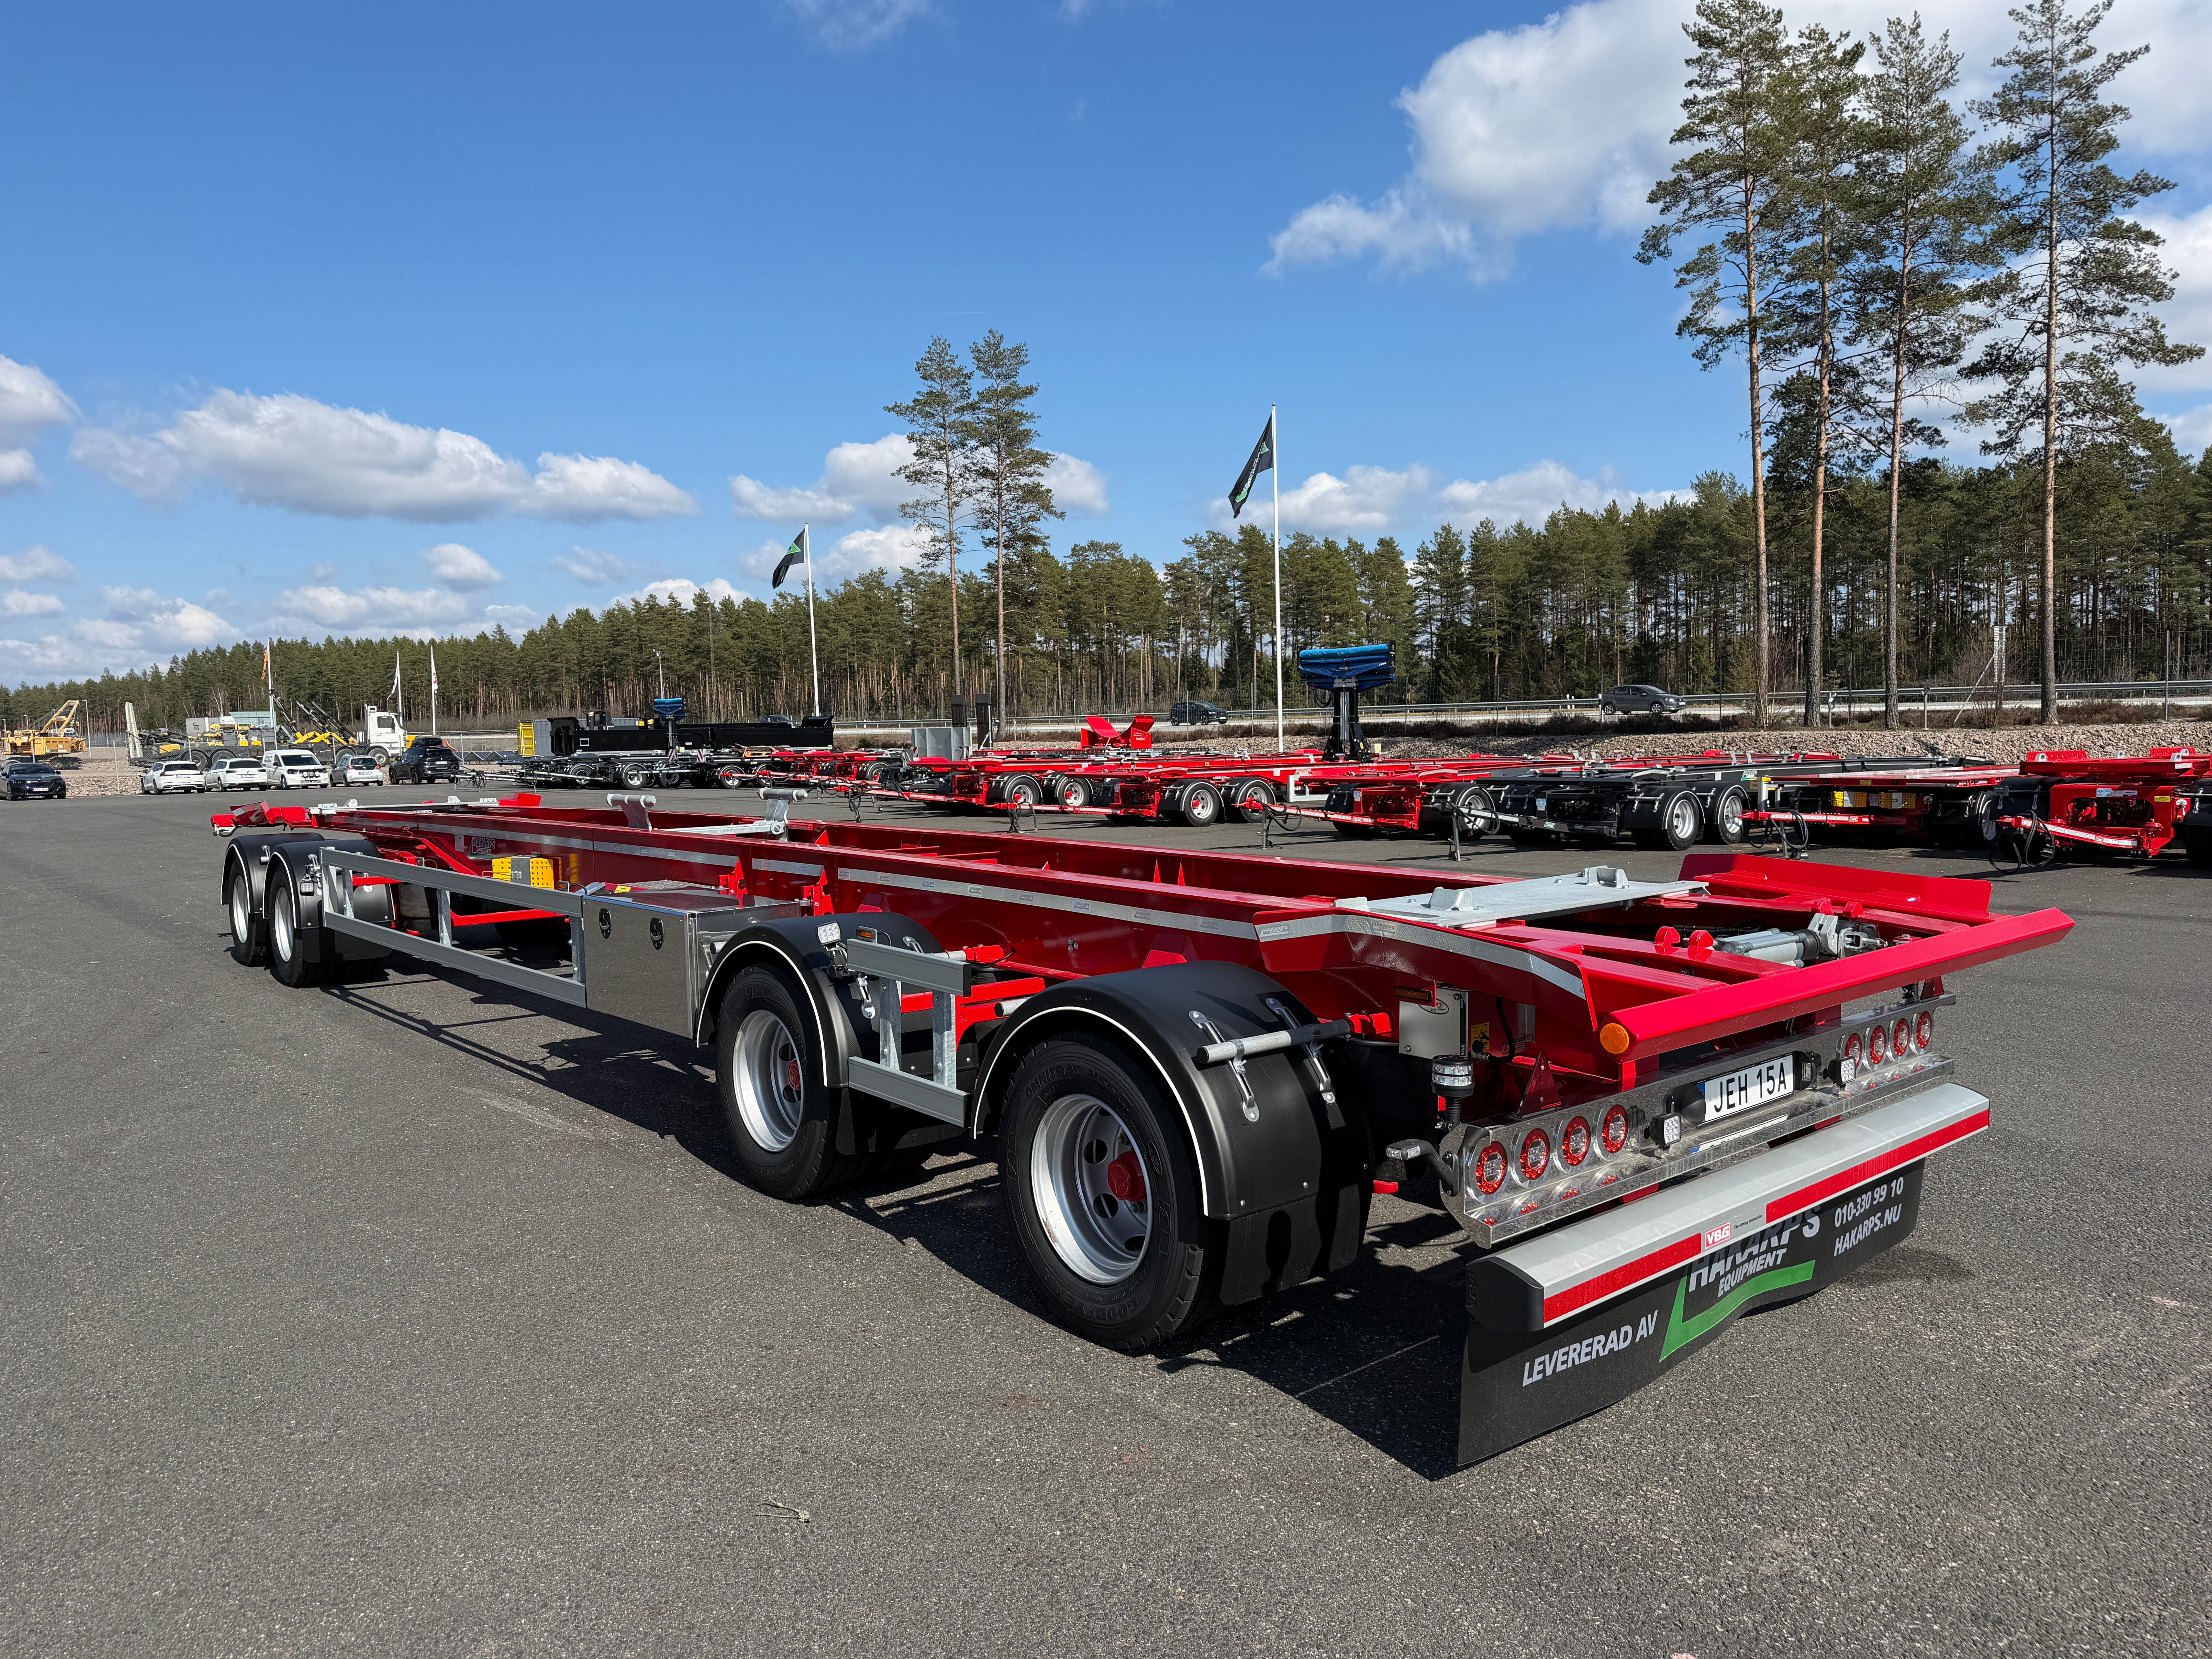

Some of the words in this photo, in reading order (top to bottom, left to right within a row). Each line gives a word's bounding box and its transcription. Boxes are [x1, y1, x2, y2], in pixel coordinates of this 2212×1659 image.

[1025, 1064, 1082, 1099] OMNITRAC
[1714, 1073, 1748, 1113] JEH
[1756, 1062, 1787, 1098] 15A
[1748, 1214, 1763, 1223] connection
[1835, 1194, 1871, 1228] 010-330
[1872, 1186, 1887, 1205] 99
[1891, 1176, 1904, 1197] 10
[1688, 1204, 1821, 1292] HAKARPS
[1707, 1225, 1729, 1244] VBG
[1834, 1203, 1902, 1257] HAKARPS.NU
[1717, 1248, 1787, 1297] EQUIPMENT
[1522, 1325, 1633, 1387] LEVERERAD
[1635, 1309, 1659, 1343] AV
